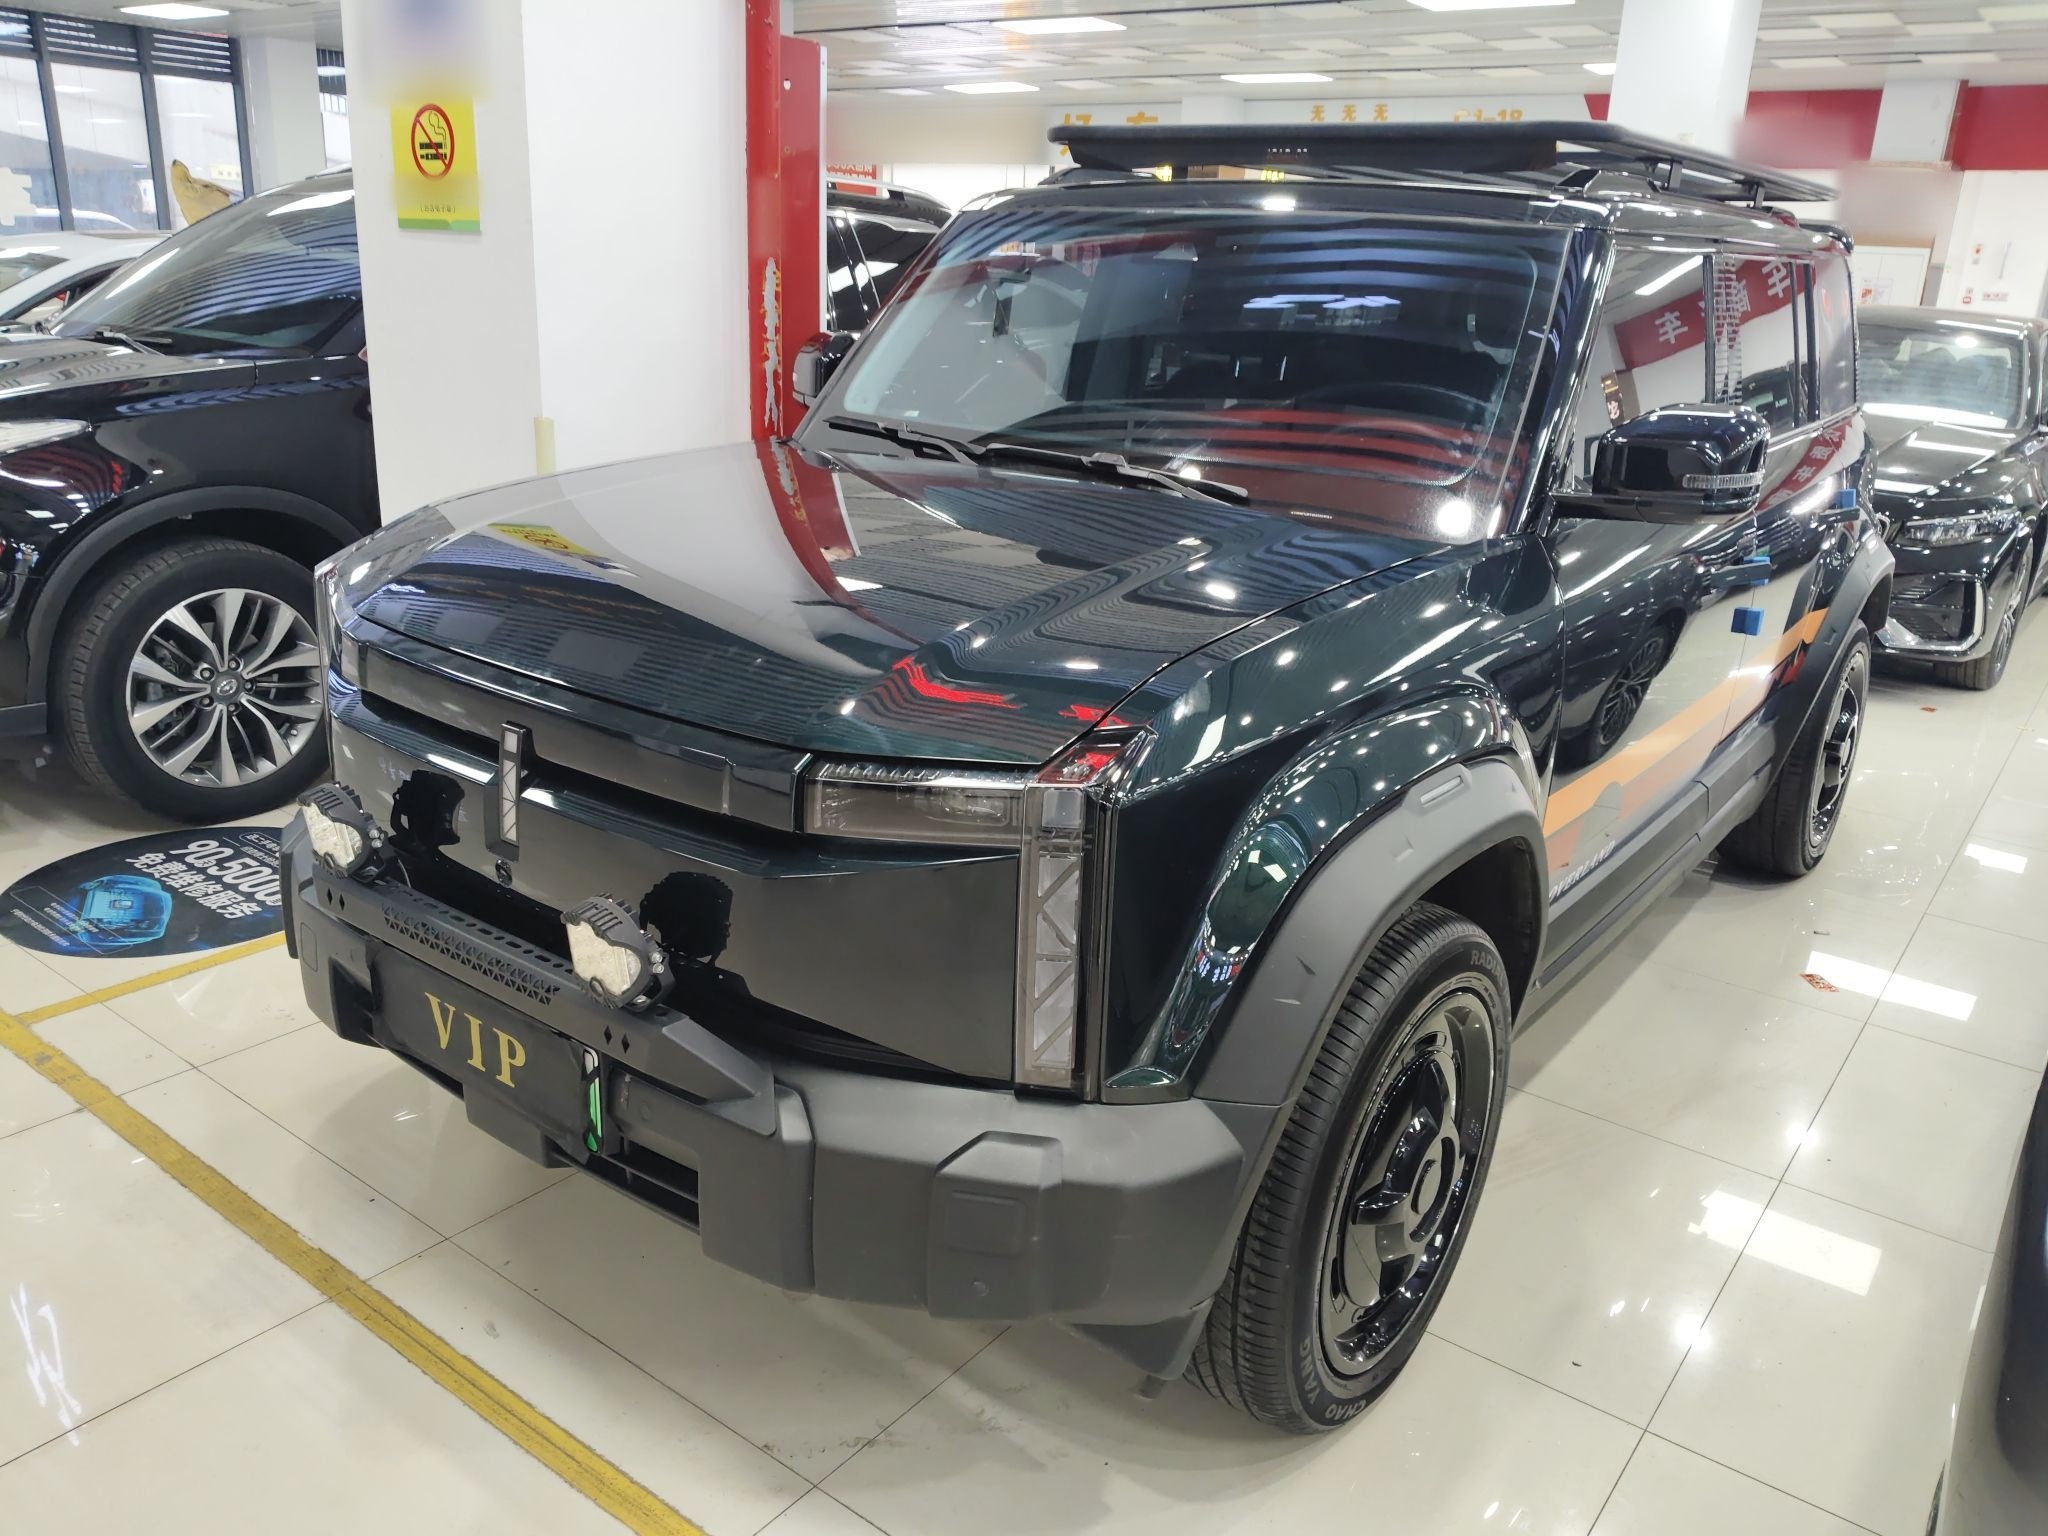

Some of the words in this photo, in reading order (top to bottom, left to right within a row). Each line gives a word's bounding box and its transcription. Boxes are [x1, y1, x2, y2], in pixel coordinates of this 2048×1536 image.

[126, 852, 263, 919] 免费维修服务
[425, 992, 526, 1088] VIP
